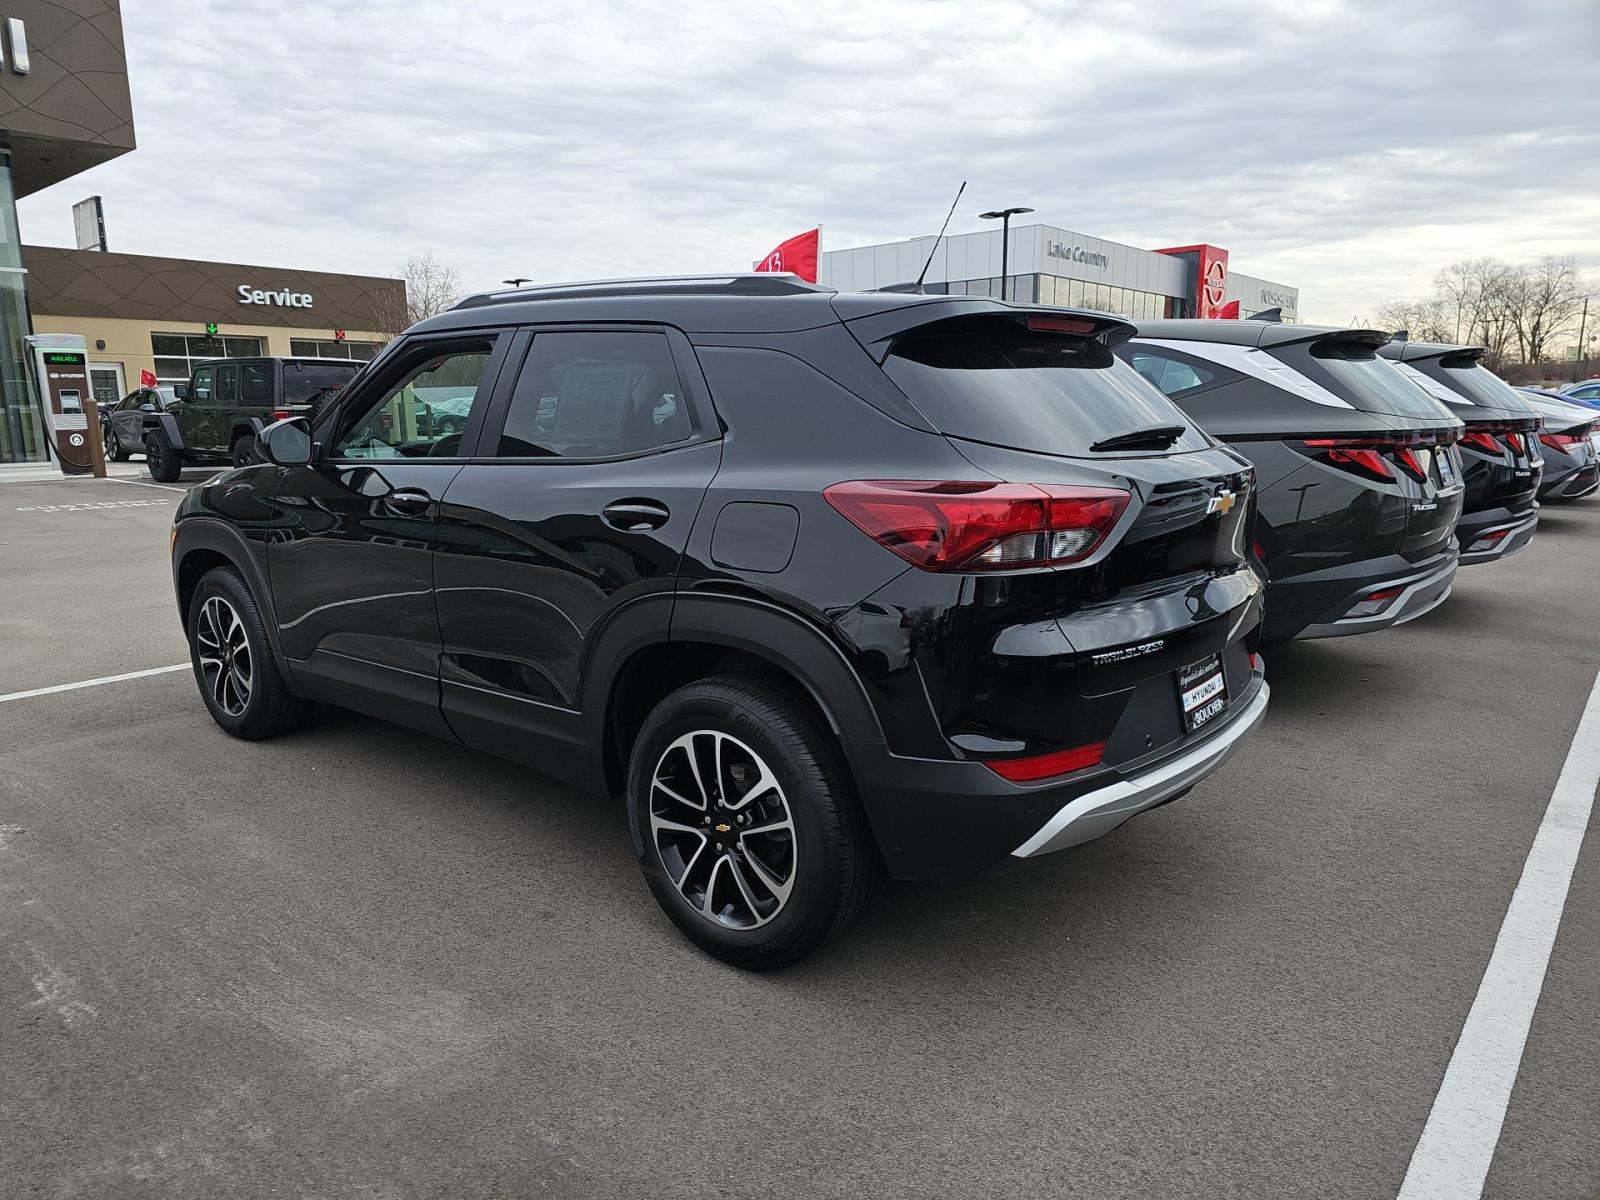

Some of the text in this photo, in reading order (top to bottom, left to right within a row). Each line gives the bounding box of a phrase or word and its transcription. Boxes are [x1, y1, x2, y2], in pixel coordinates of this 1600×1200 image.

[1047, 240, 1110, 272] Lake Country
[238, 284, 313, 308] Service
[1260, 288, 1296, 310] NISSAN
[1092, 640, 1164, 666] TRAILBLAZER
[1191, 680, 1217, 703] HYUNDAI
